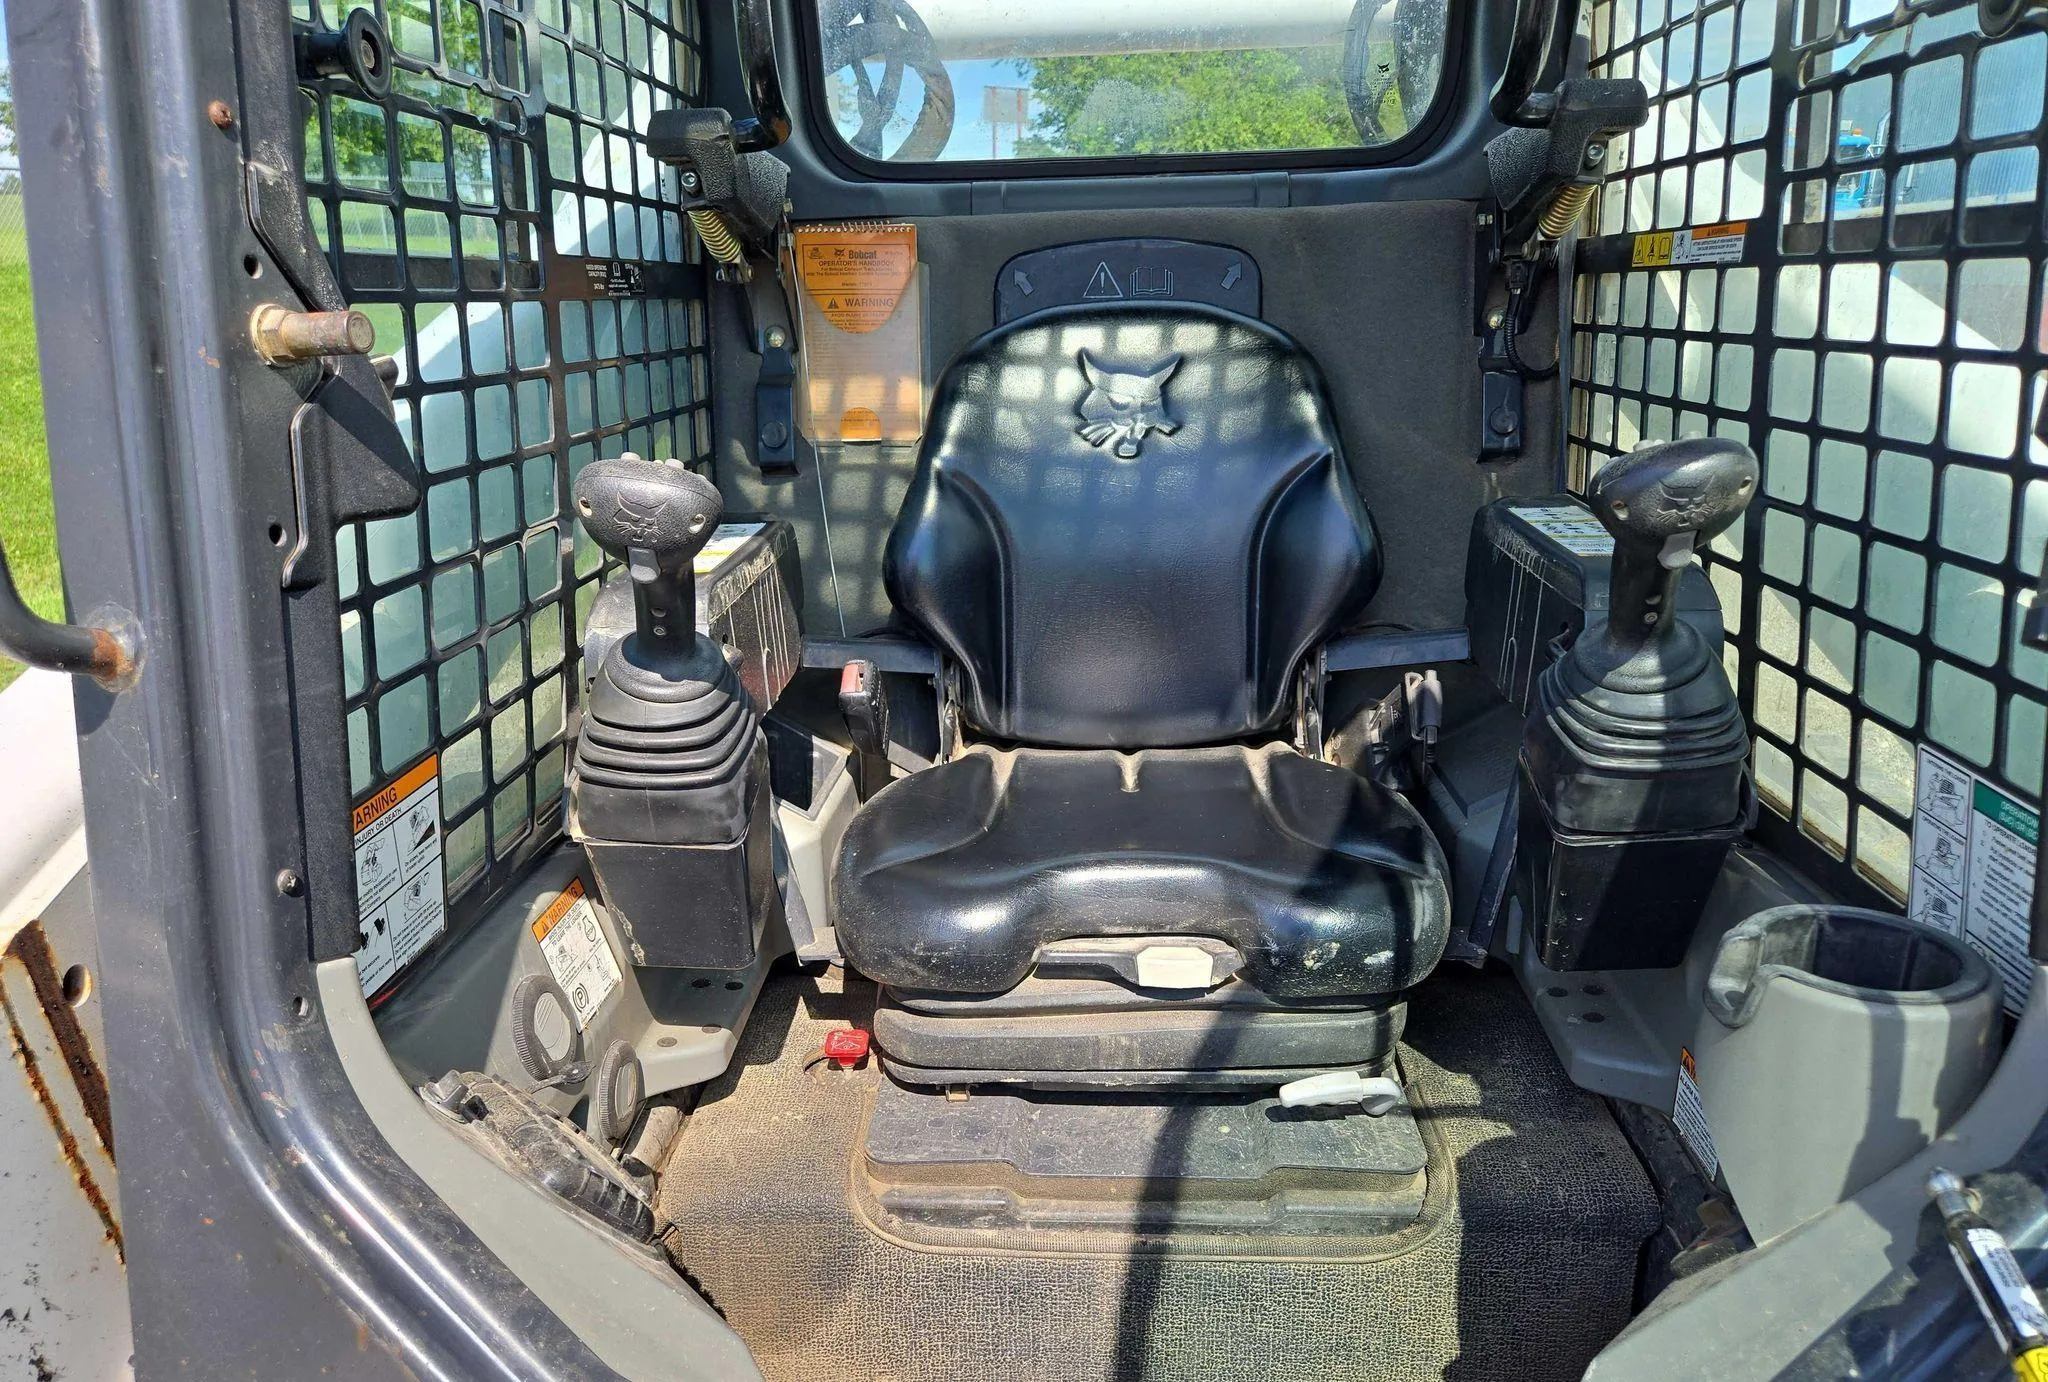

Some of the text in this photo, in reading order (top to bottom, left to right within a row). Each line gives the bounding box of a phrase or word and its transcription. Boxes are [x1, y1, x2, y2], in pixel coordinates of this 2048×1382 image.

[848, 249, 877, 260] Bobcat
[845, 298, 893, 307] WARNING
[2001, 801, 2037, 828] OPERATION
[545, 888, 577, 924] WARNING
